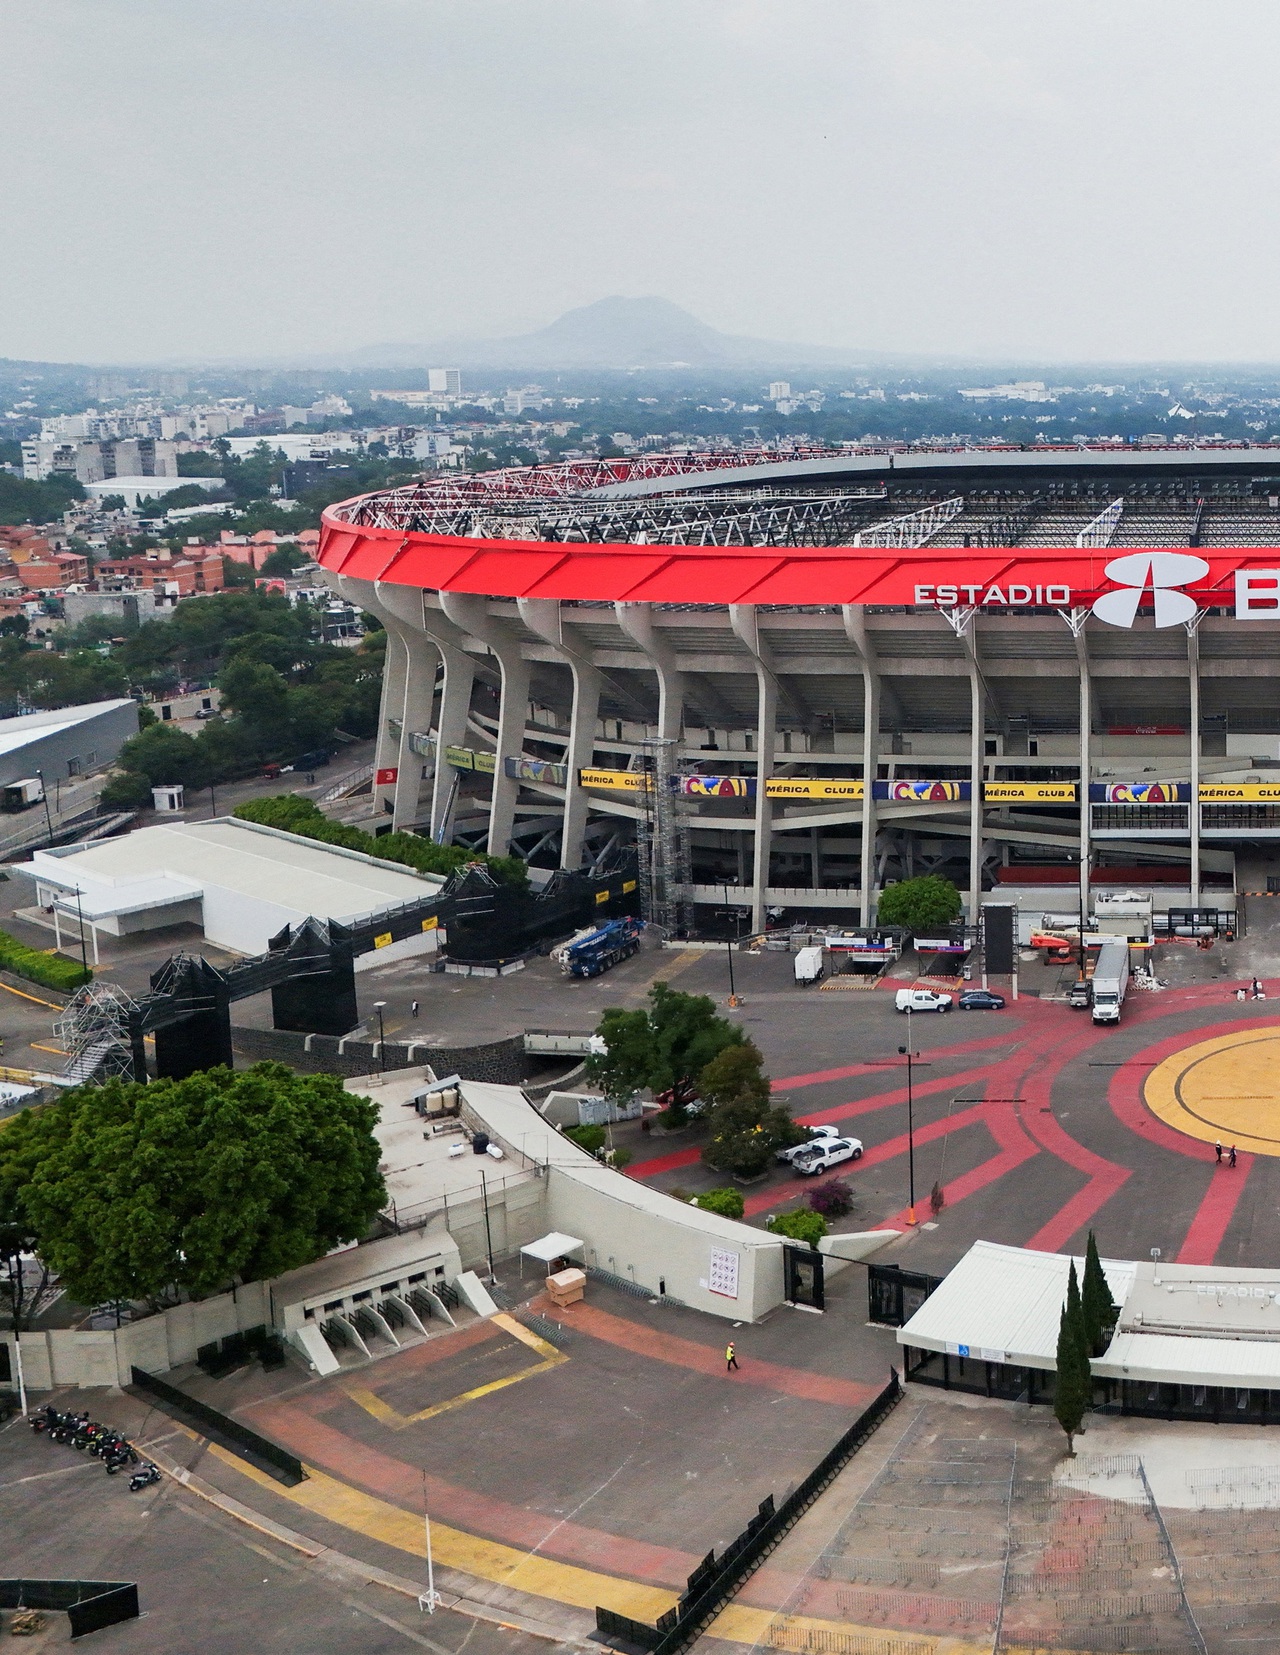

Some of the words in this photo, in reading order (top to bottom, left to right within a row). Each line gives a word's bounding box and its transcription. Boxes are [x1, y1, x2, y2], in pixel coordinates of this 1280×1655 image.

[914, 584, 1071, 606] ESTADIO
[386, 771, 394, 780] 3
[582, 775, 614, 785] MÉRICA
[766, 785, 810, 794] MÉRICA
[824, 786, 855, 794] CLUB
[984, 789, 1025, 797] MÉRICA
[1037, 790, 1065, 798] CLUB
[1198, 788, 1244, 797] MÉRICA
[1196, 1284, 1266, 1299] ESTADIO
